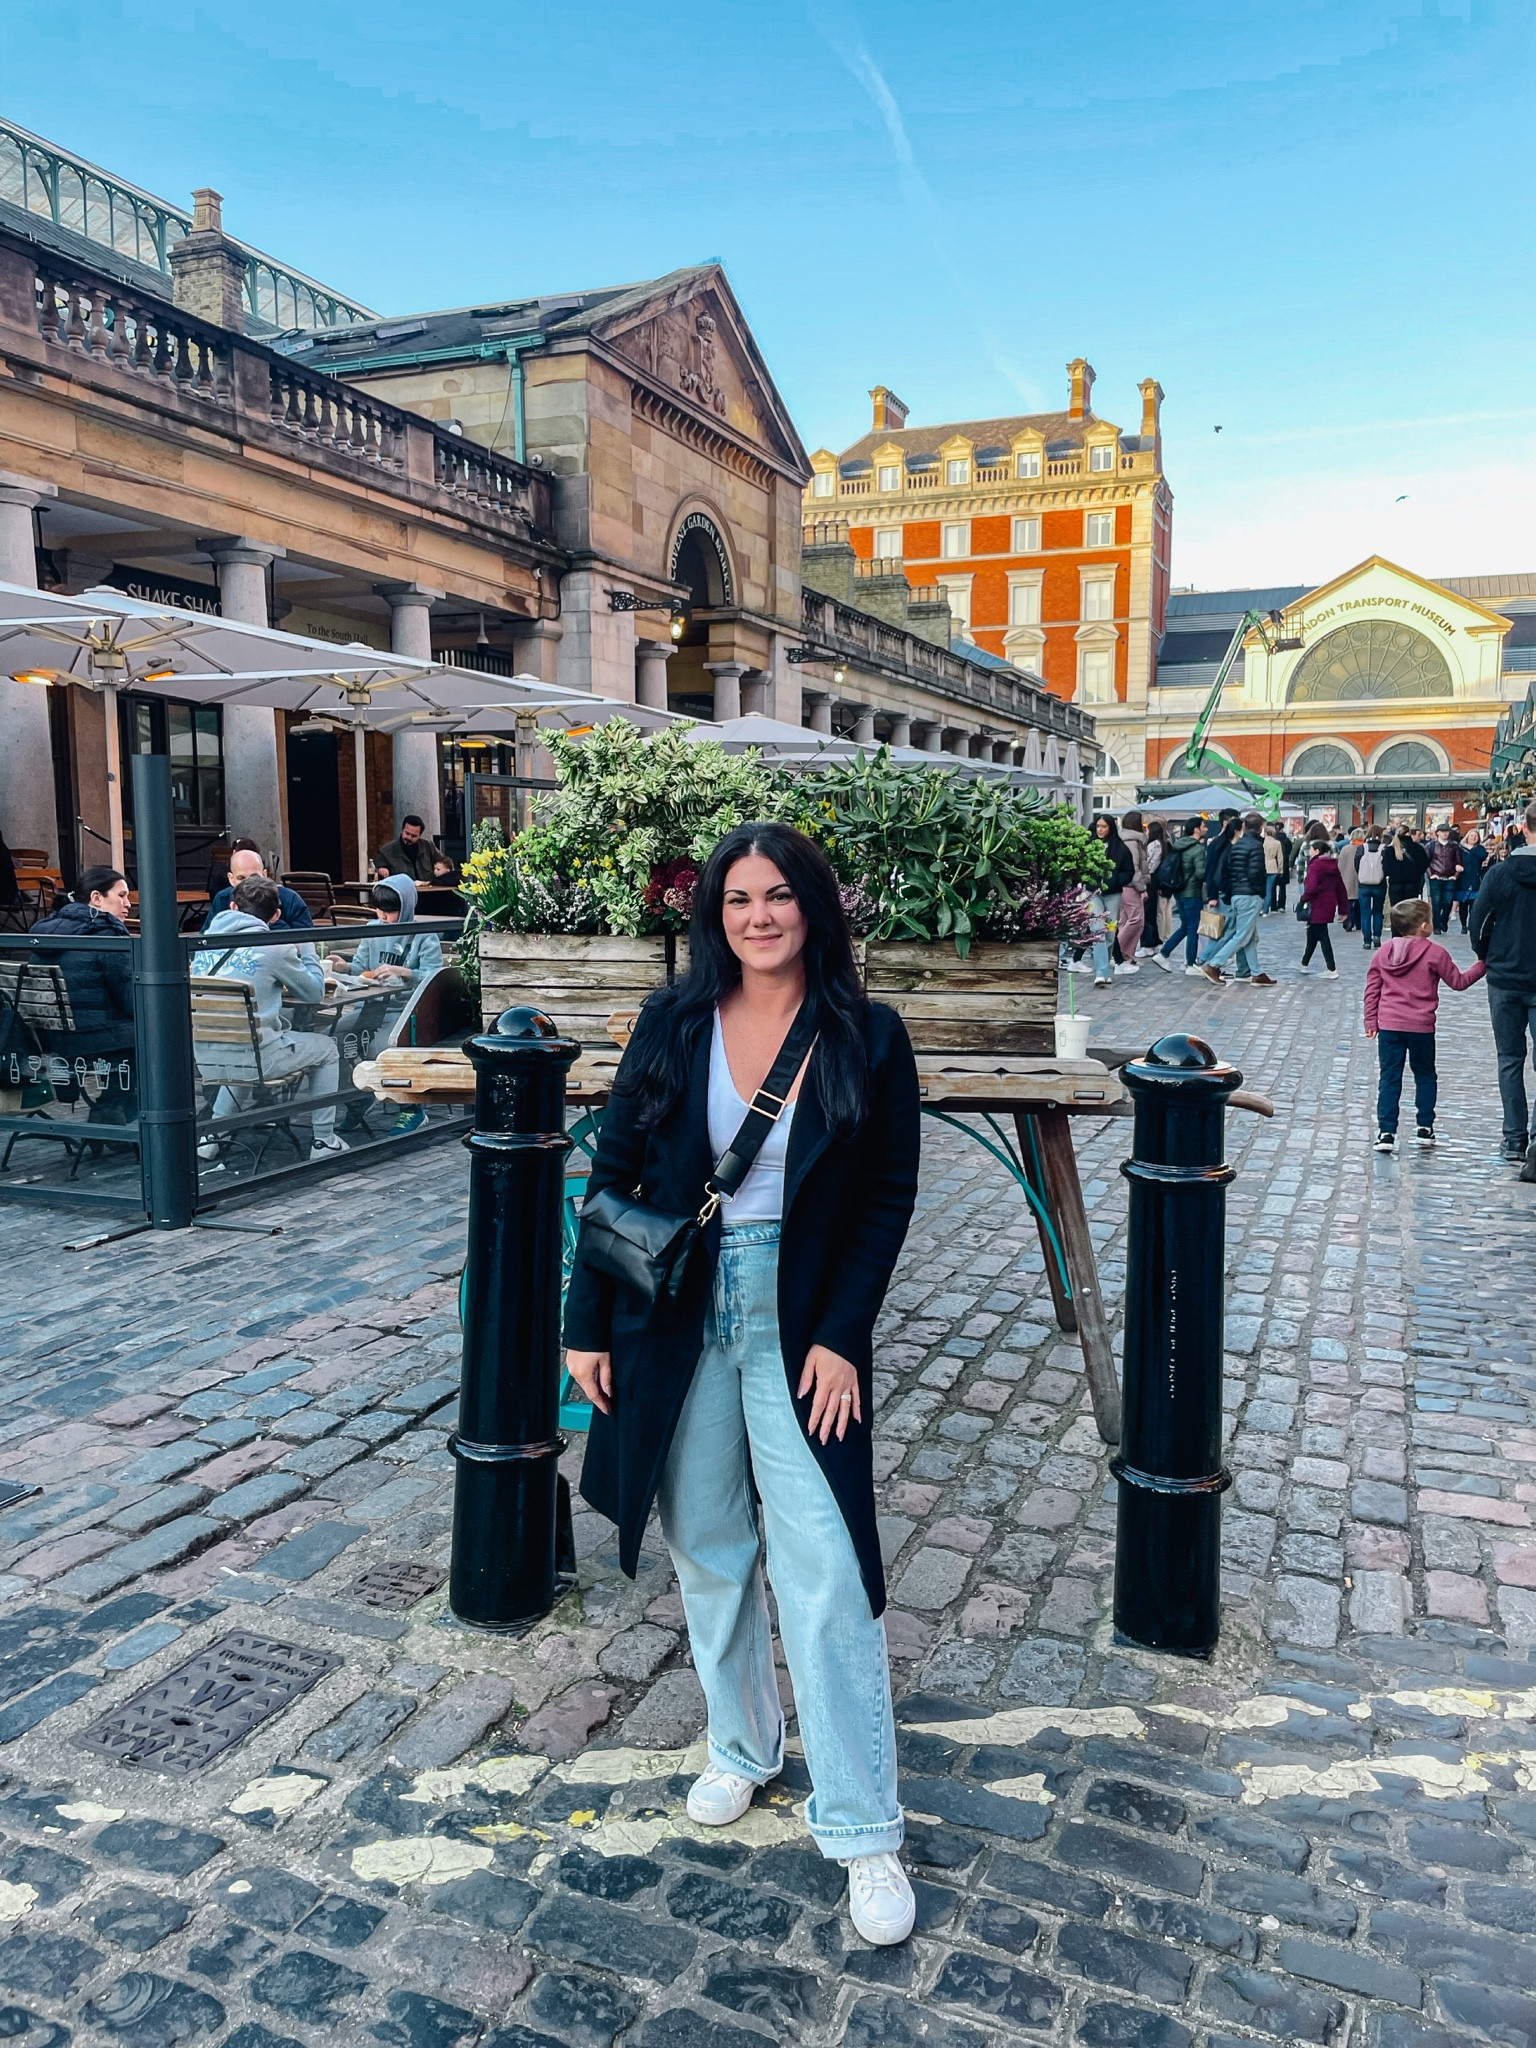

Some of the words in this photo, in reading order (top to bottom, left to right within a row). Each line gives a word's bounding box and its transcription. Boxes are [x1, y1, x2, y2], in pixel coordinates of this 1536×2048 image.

[671, 523, 689, 580] COVENT
[687, 514, 716, 540] GARDEN
[127, 582, 181, 607] SHAKE
[183, 594, 222, 617] SHAC
[1337, 597, 1410, 613] TRANSPORT
[1411, 603, 1457, 637] MUSEUM
[306, 623, 317, 634] To
[317, 625, 330, 637] the
[331, 628, 352, 642] South
[353, 633, 368, 645] Hall
